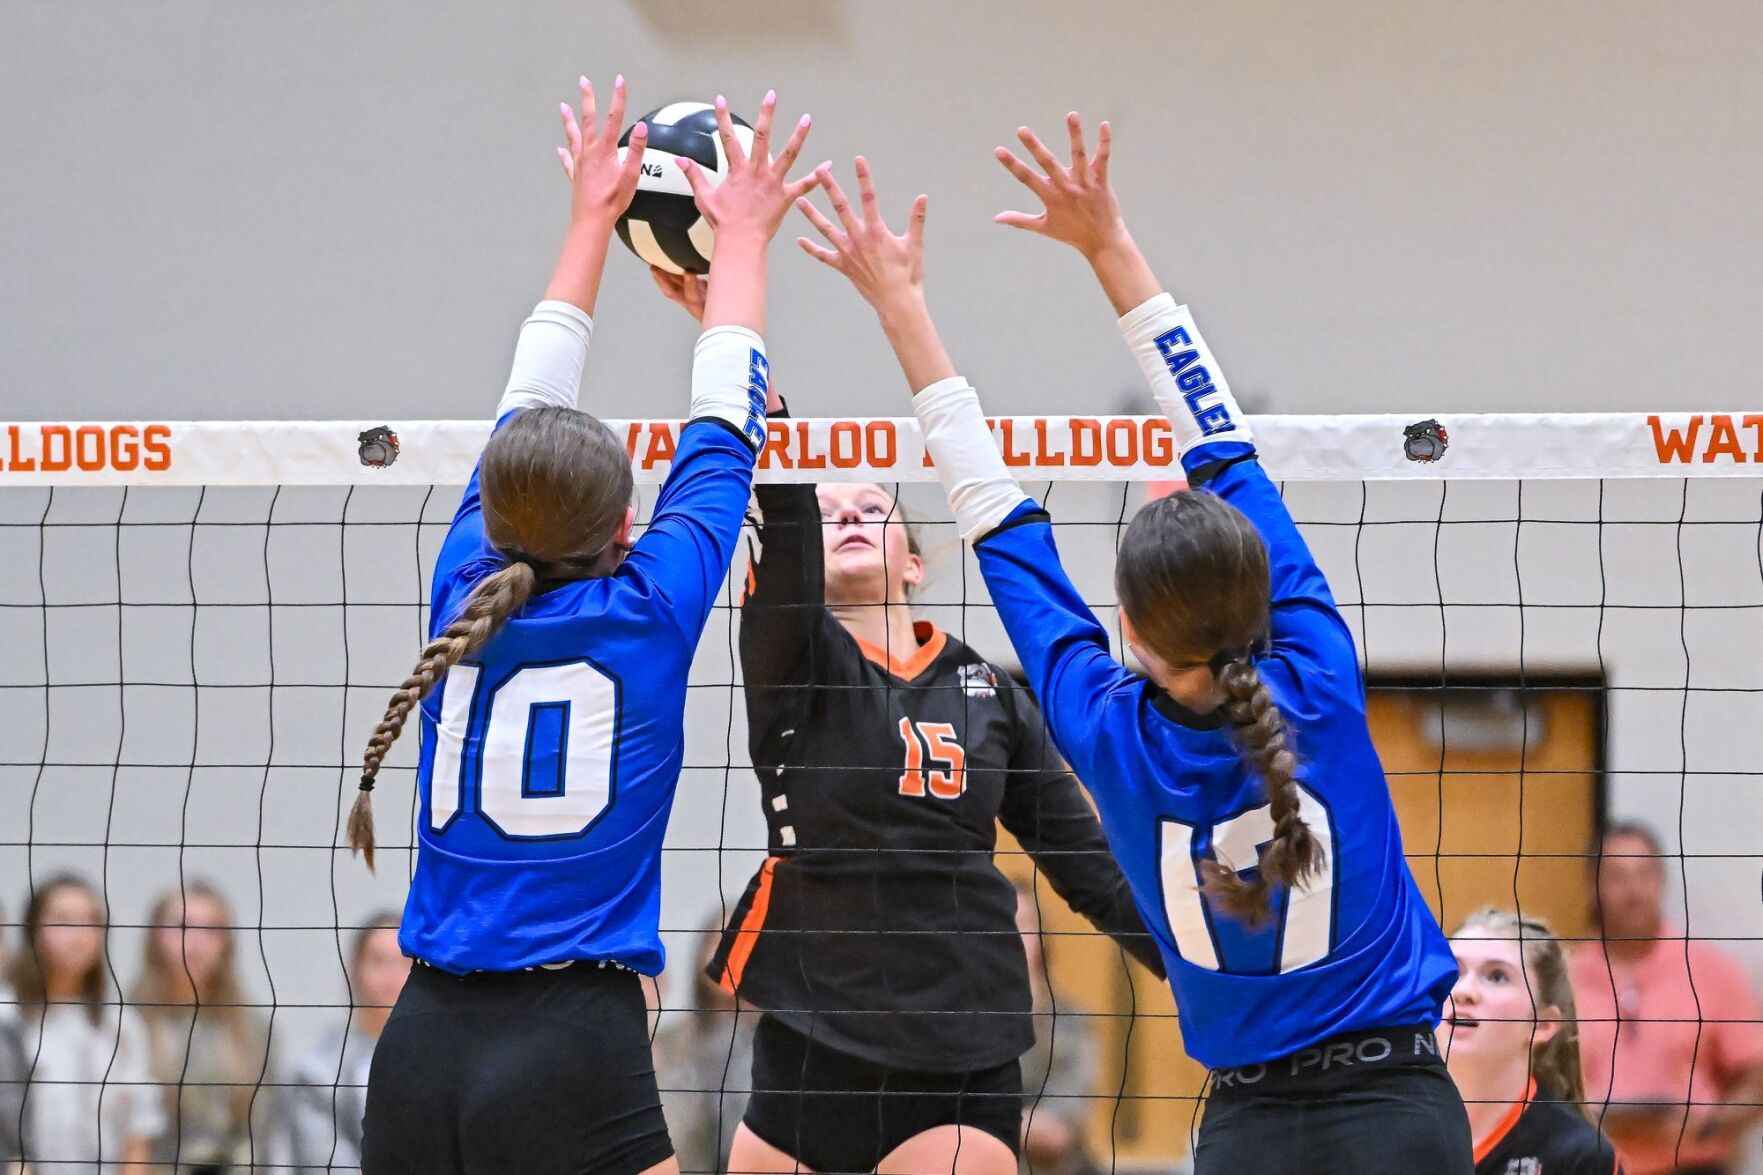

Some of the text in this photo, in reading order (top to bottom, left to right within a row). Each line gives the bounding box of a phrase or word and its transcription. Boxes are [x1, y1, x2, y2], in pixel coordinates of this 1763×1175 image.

[0, 425, 172, 471] LDOGS
[627, 418, 1181, 469] ARLOO LLDOG
[899, 716, 967, 799] 15
[1211, 1063, 1267, 1090] RO
[1290, 1037, 1391, 1076] PRO
